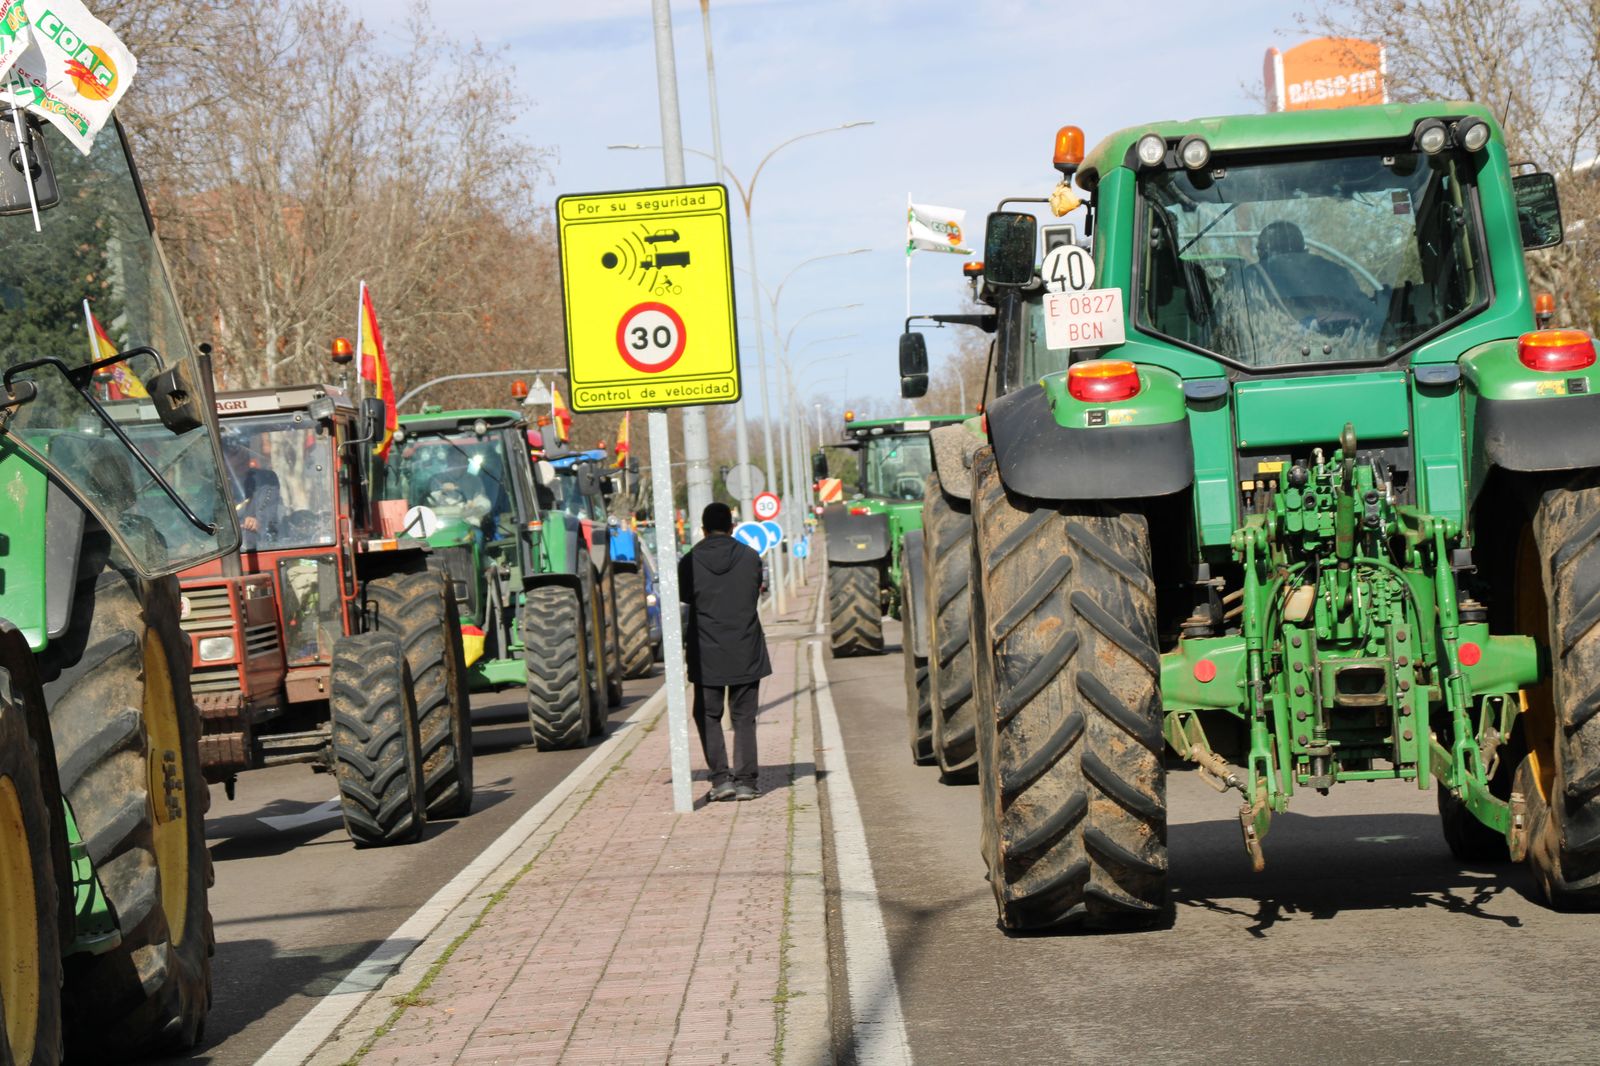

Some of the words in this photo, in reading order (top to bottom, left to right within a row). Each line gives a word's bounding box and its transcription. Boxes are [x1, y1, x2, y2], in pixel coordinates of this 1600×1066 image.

[36, 10, 115, 87] COAG
[577, 203, 600, 214] Por
[610, 202, 627, 212] su
[636, 194, 706, 211] seguridad
[1051, 251, 1085, 292] 40
[1050, 299, 1060, 317] E
[1069, 294, 1115, 316] 0827
[631, 325, 671, 350] 30
[1069, 321, 1104, 342] BCN
[580, 388, 631, 403] Control
[640, 387, 656, 399] de
[665, 383, 730, 397] velocidad
[759, 501, 774, 511] 30
